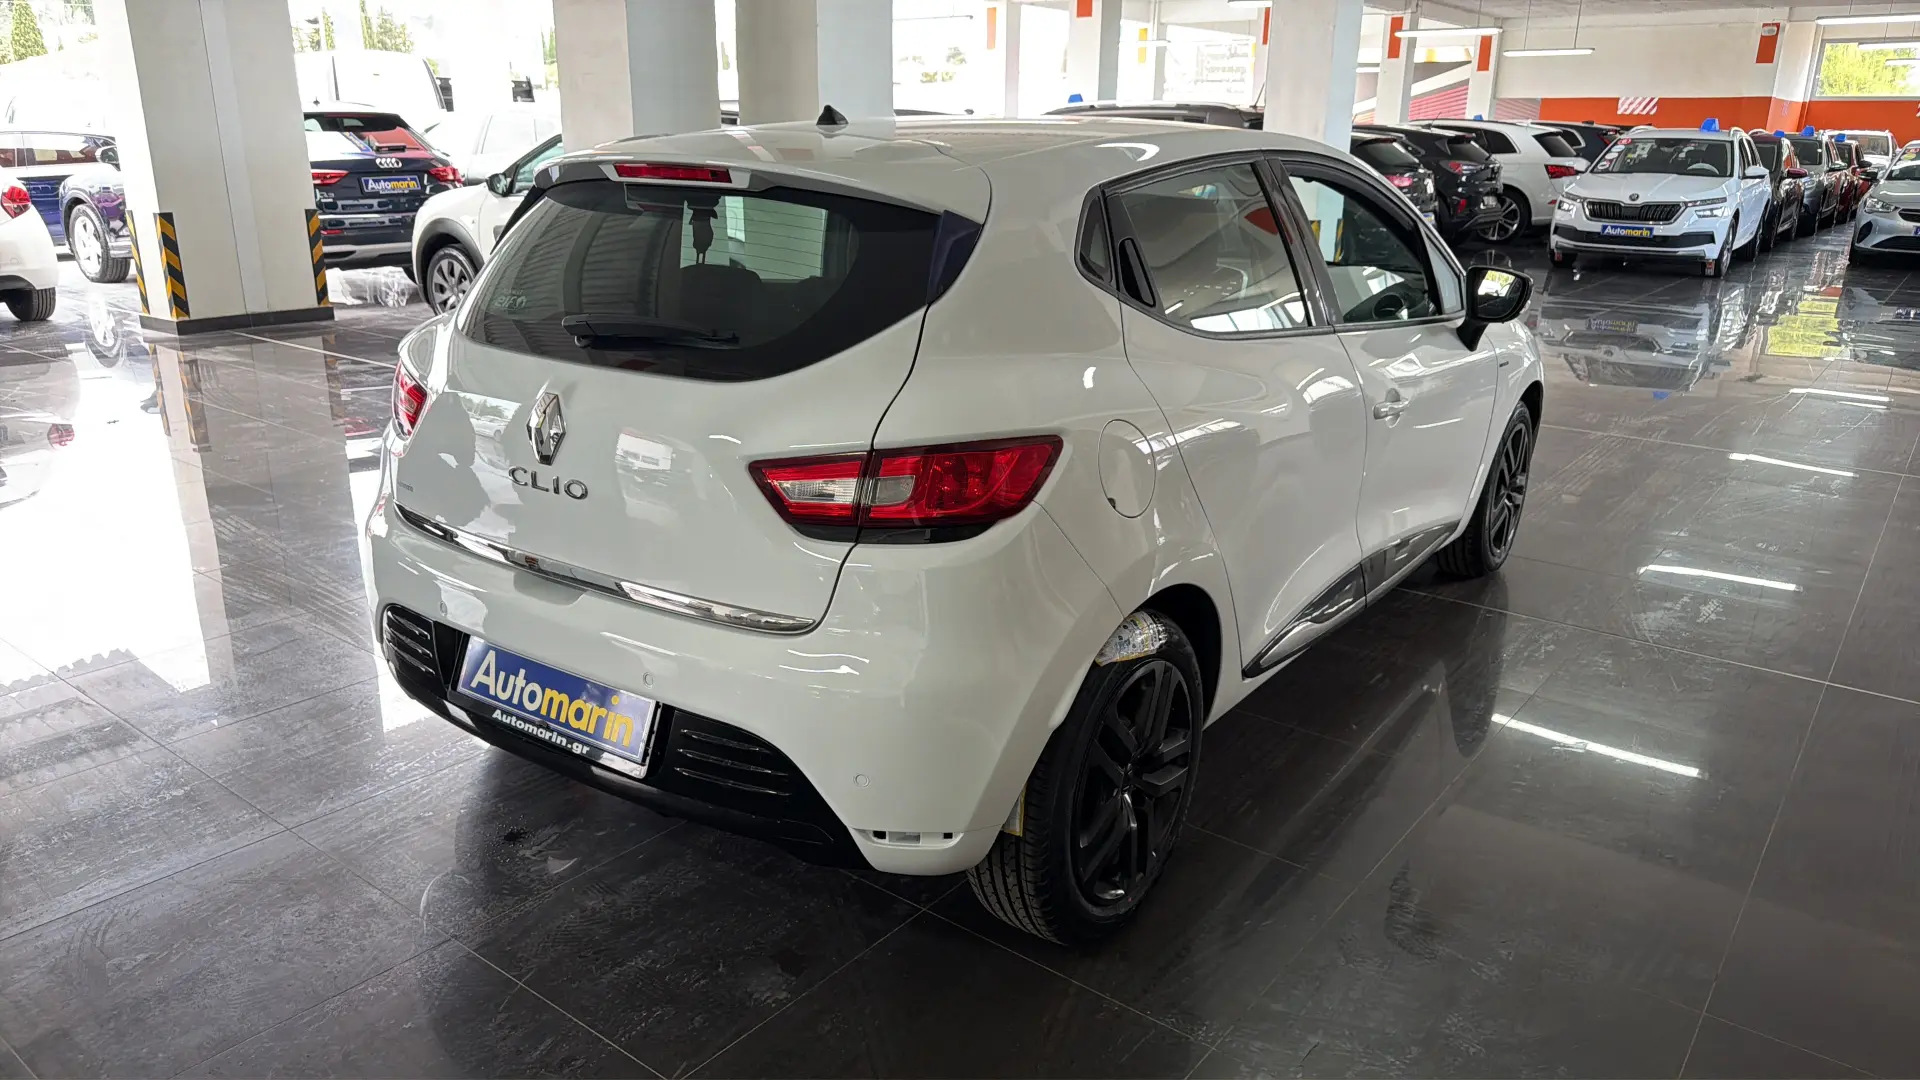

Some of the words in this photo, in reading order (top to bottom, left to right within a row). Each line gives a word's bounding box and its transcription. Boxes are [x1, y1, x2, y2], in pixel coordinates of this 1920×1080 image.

[368, 177, 417, 191] Automarin
[1604, 225, 1650, 237] Automarin
[508, 466, 588, 500] CLIO
[470, 650, 634, 747] Automarin
[492, 709, 590, 755] Automarin.gr
